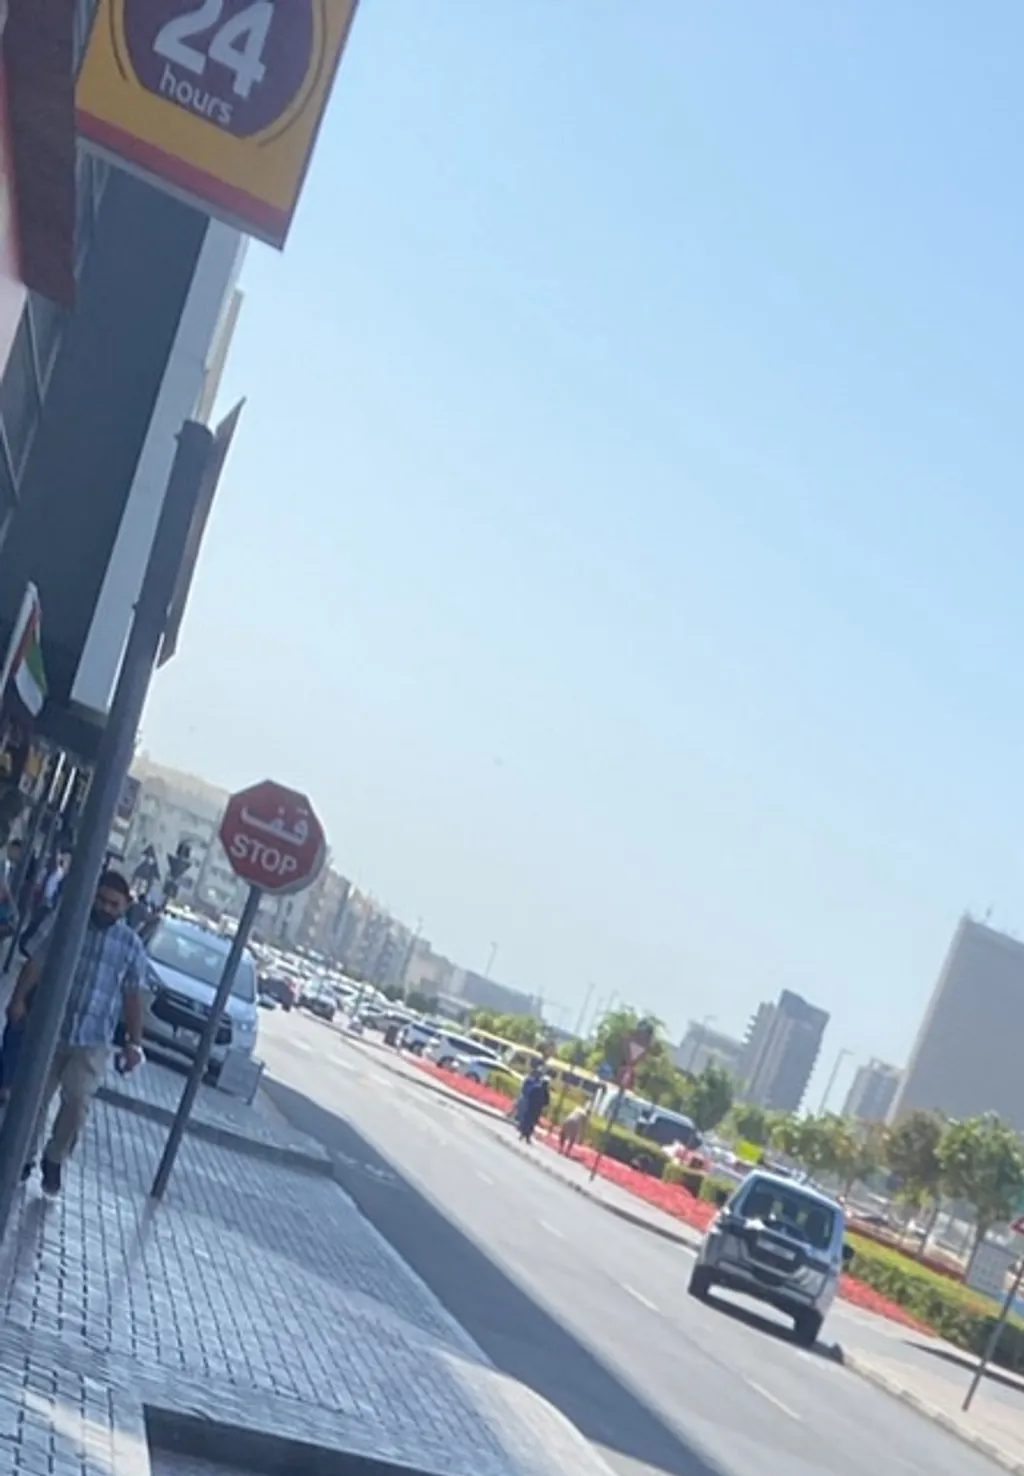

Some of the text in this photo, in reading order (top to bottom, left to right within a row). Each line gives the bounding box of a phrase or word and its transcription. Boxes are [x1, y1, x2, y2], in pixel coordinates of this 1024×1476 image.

[153, 0, 274, 98] 24
[159, 62, 234, 126] hours
[240, 805, 310, 847] قف
[229, 833, 299, 876] STOP
